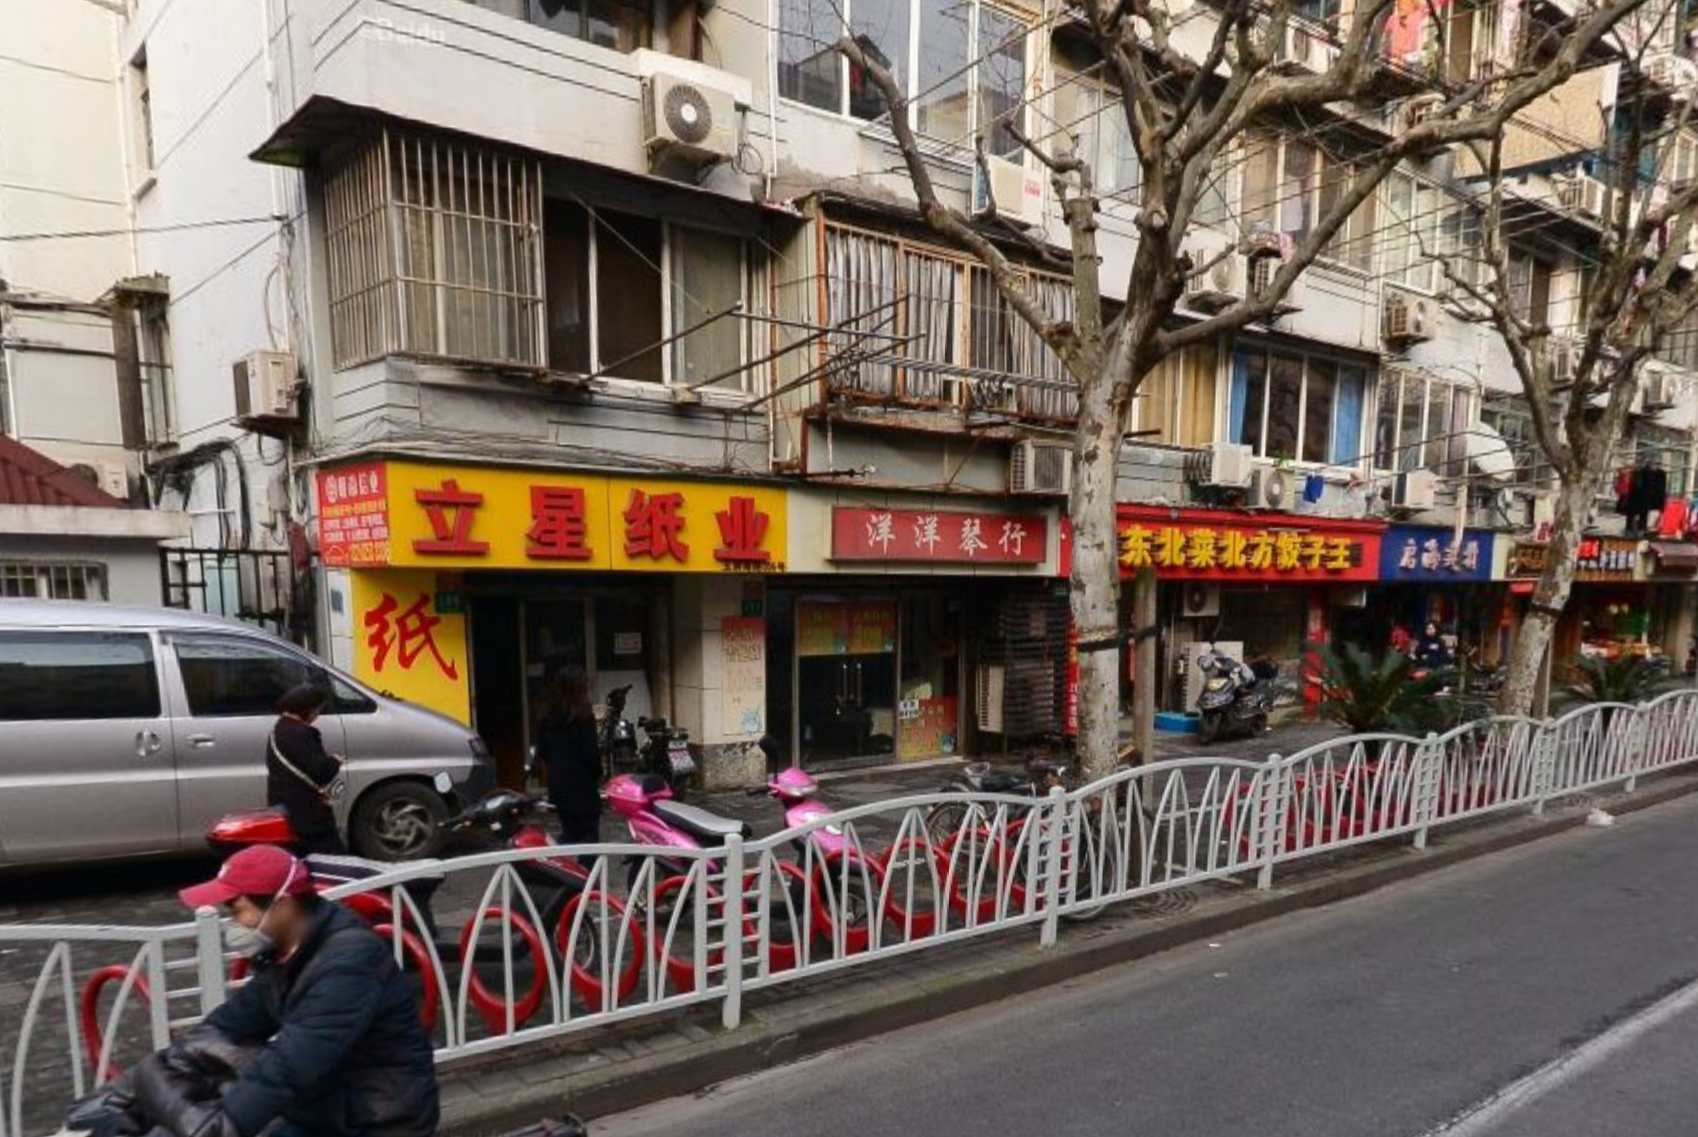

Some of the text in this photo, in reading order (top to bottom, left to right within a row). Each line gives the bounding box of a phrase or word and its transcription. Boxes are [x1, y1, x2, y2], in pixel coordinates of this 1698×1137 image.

[413, 479, 771, 563] 立星纸业
[866, 513, 1027, 557] 洋洋琴行
[1121, 526, 1351, 569] 东北菜北方饺子王
[364, 593, 459, 681] 纸
